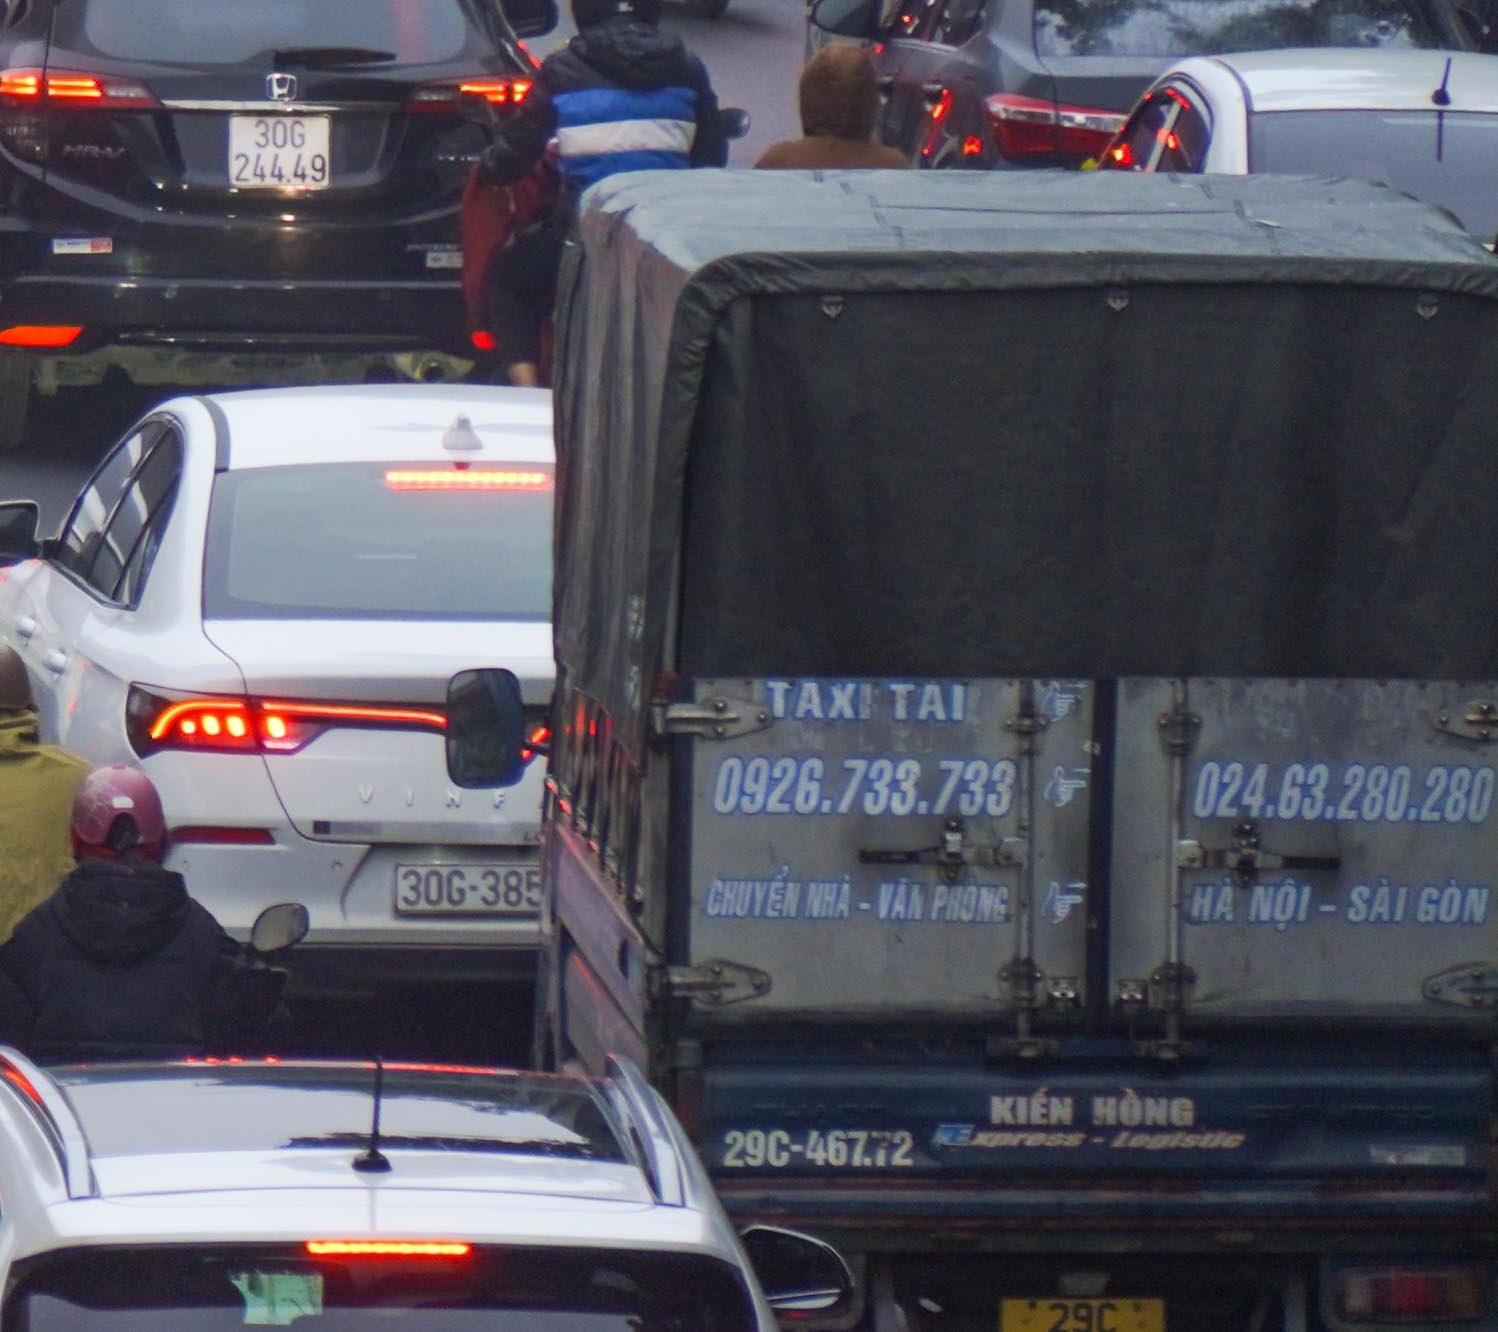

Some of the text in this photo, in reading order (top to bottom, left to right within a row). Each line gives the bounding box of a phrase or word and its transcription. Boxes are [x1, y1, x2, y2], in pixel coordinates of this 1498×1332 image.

[254, 119, 306, 149] 30G
[235, 153, 325, 183] 244.49
[766, 681, 871, 720] TAXI
[712, 758, 1017, 815] 0926.733.733
[1193, 762, 1494, 823] 024.63.280.280
[804, 873, 850, 917] NHÀ
[878, 877, 925, 921] VĂN
[1189, 878, 1233, 922] HÀ
[1248, 878, 1312, 931] NỘI
[1347, 878, 1408, 924] SÀI
[1417, 879, 1489, 925] GÒN
[1049, 1302, 1118, 1332] 29C
